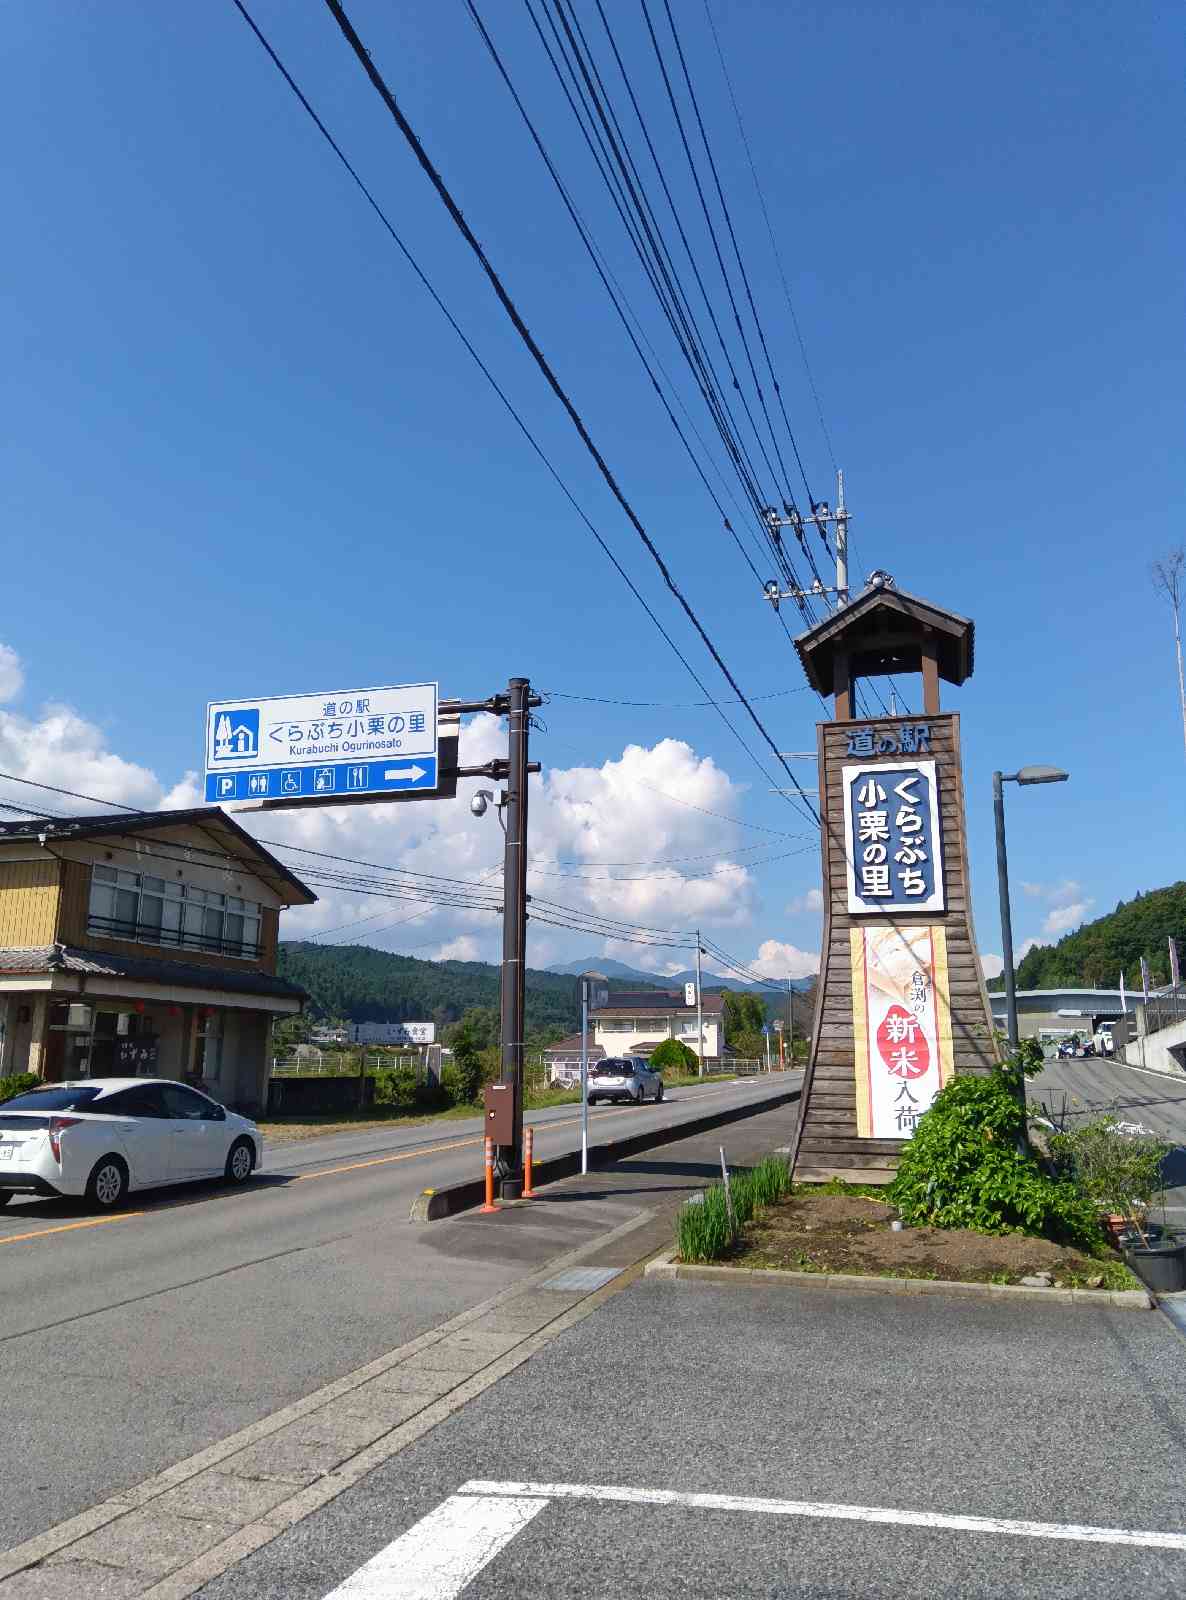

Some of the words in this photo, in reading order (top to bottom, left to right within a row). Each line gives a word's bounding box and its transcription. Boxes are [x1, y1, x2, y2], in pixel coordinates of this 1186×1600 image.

[323, 699, 370, 717] 道の駅
[268, 713, 426, 743] くらぶち小栗の里
[847, 723, 931, 757] 道の駅
[289, 743, 339, 756] Kurabuchi
[342, 738, 402, 753] Ogurinosato
[857, 779, 893, 896] 小栗の里
[894, 777, 928, 895] くらぶち
